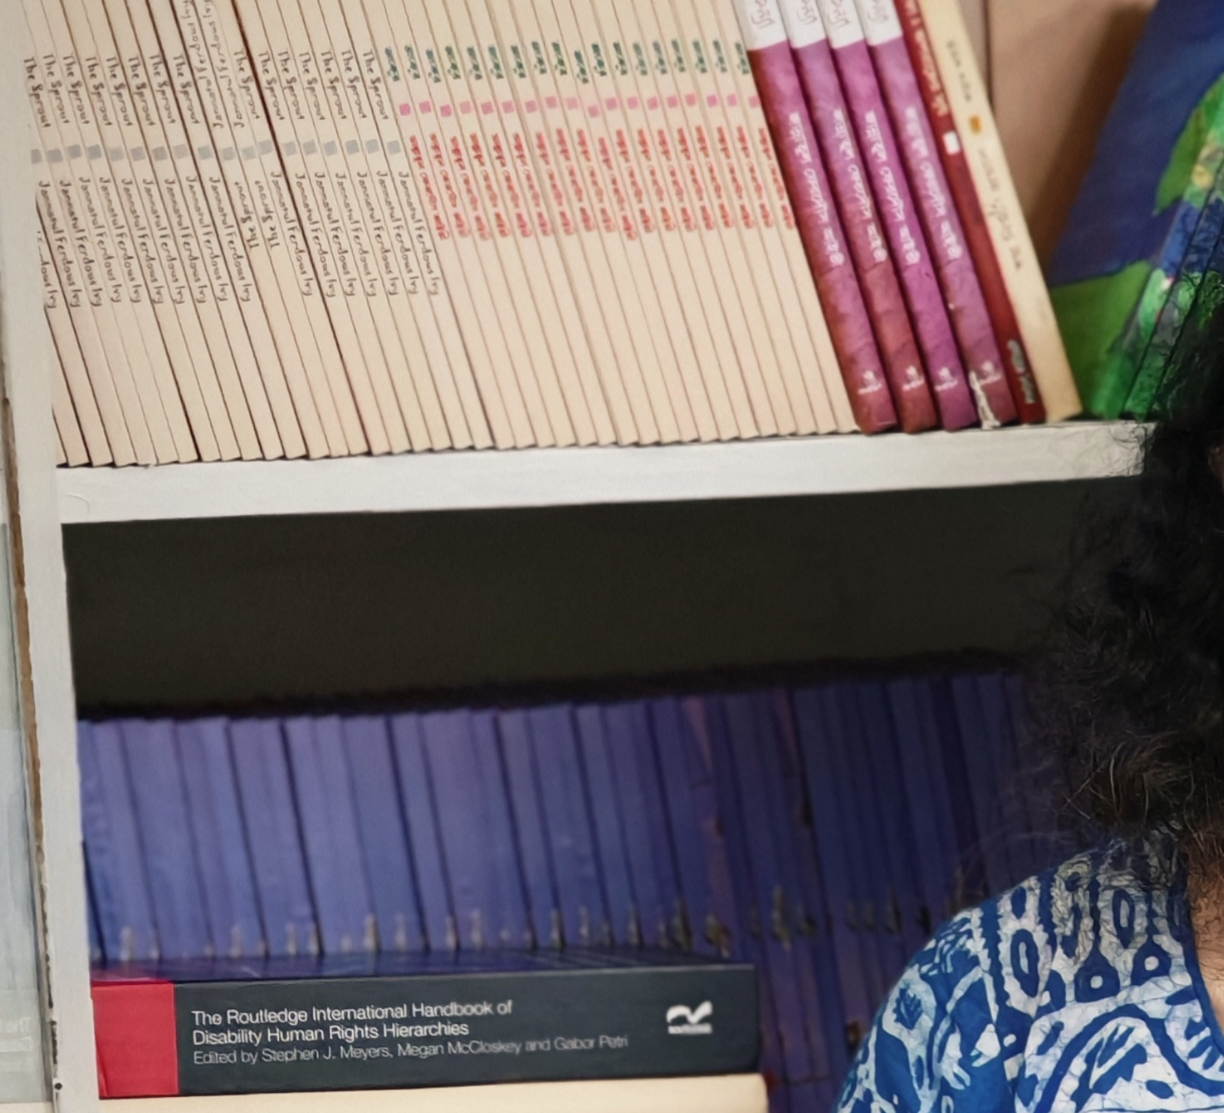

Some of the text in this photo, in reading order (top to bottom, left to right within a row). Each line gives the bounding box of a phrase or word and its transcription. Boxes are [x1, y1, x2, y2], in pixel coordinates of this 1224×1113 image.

[24, 57, 50, 126] The Sprout
[43, 54, 69, 123] The Sprout
[63, 55, 89, 123] The Sprout
[85, 56, 112, 125] The Sprout
[106, 57, 132, 125] The Sprout
[128, 57, 155, 125] The Sprout
[149, 54, 175, 123] The Sprout
[173, 55, 199, 123] The Sprout
[234, 50, 259, 118] The Sprout
[259, 51, 284, 119] The Sprout
[278, 51, 304, 119] The Sprout
[299, 52, 325, 119] The Sprout
[321, 51, 346, 118] The Sprout
[341, 50, 366, 118] The Sprout
[363, 51, 388, 119] The Sprout
[234, 181, 259, 248] The Sprout
[254, 180, 279, 248] The Sprout
[191, 999, 513, 1026] The Routledge International Handbook of
[193, 1021, 469, 1046] Disability Human Rights Hierarchies
[194, 1034, 629, 1065] Edited by Stephen J. Meyers, Megan McCloskey and Gabor Petri
